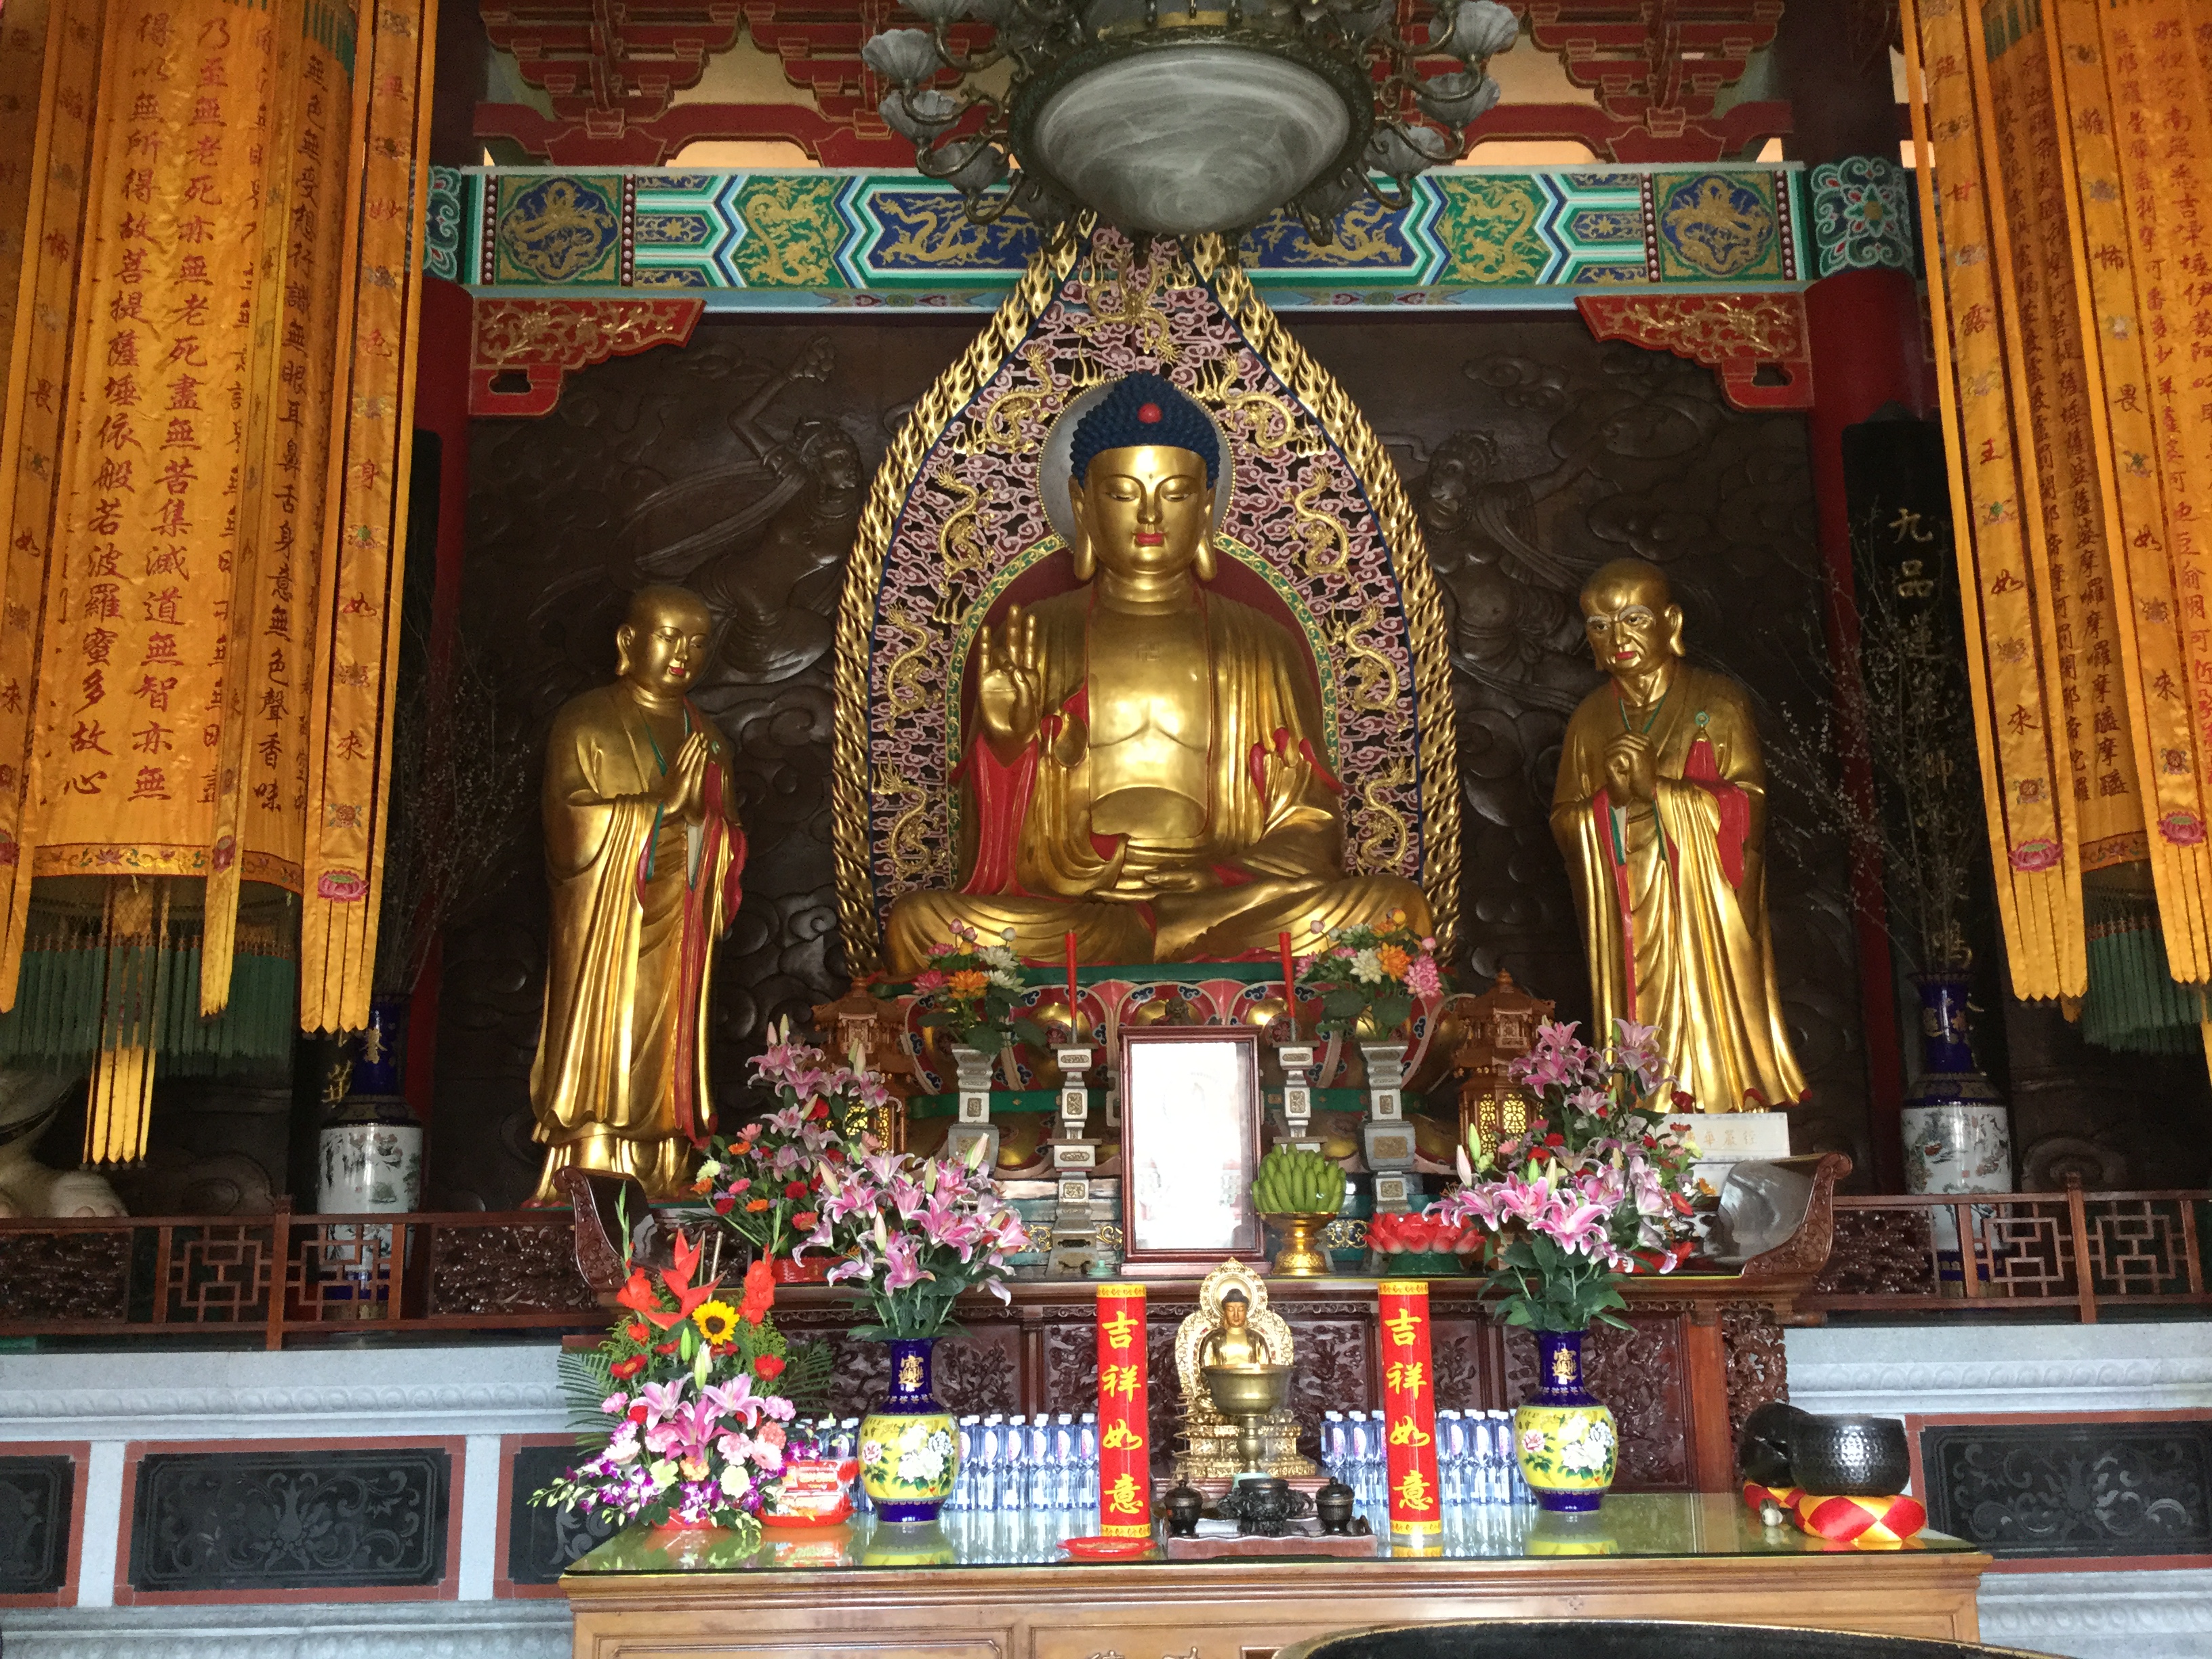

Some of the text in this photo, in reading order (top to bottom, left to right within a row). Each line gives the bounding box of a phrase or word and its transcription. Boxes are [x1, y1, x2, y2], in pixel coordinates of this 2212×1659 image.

[1101, 1311, 1144, 1515] 吉祥如意
[1385, 1308, 1434, 1511] 吉祥如意
